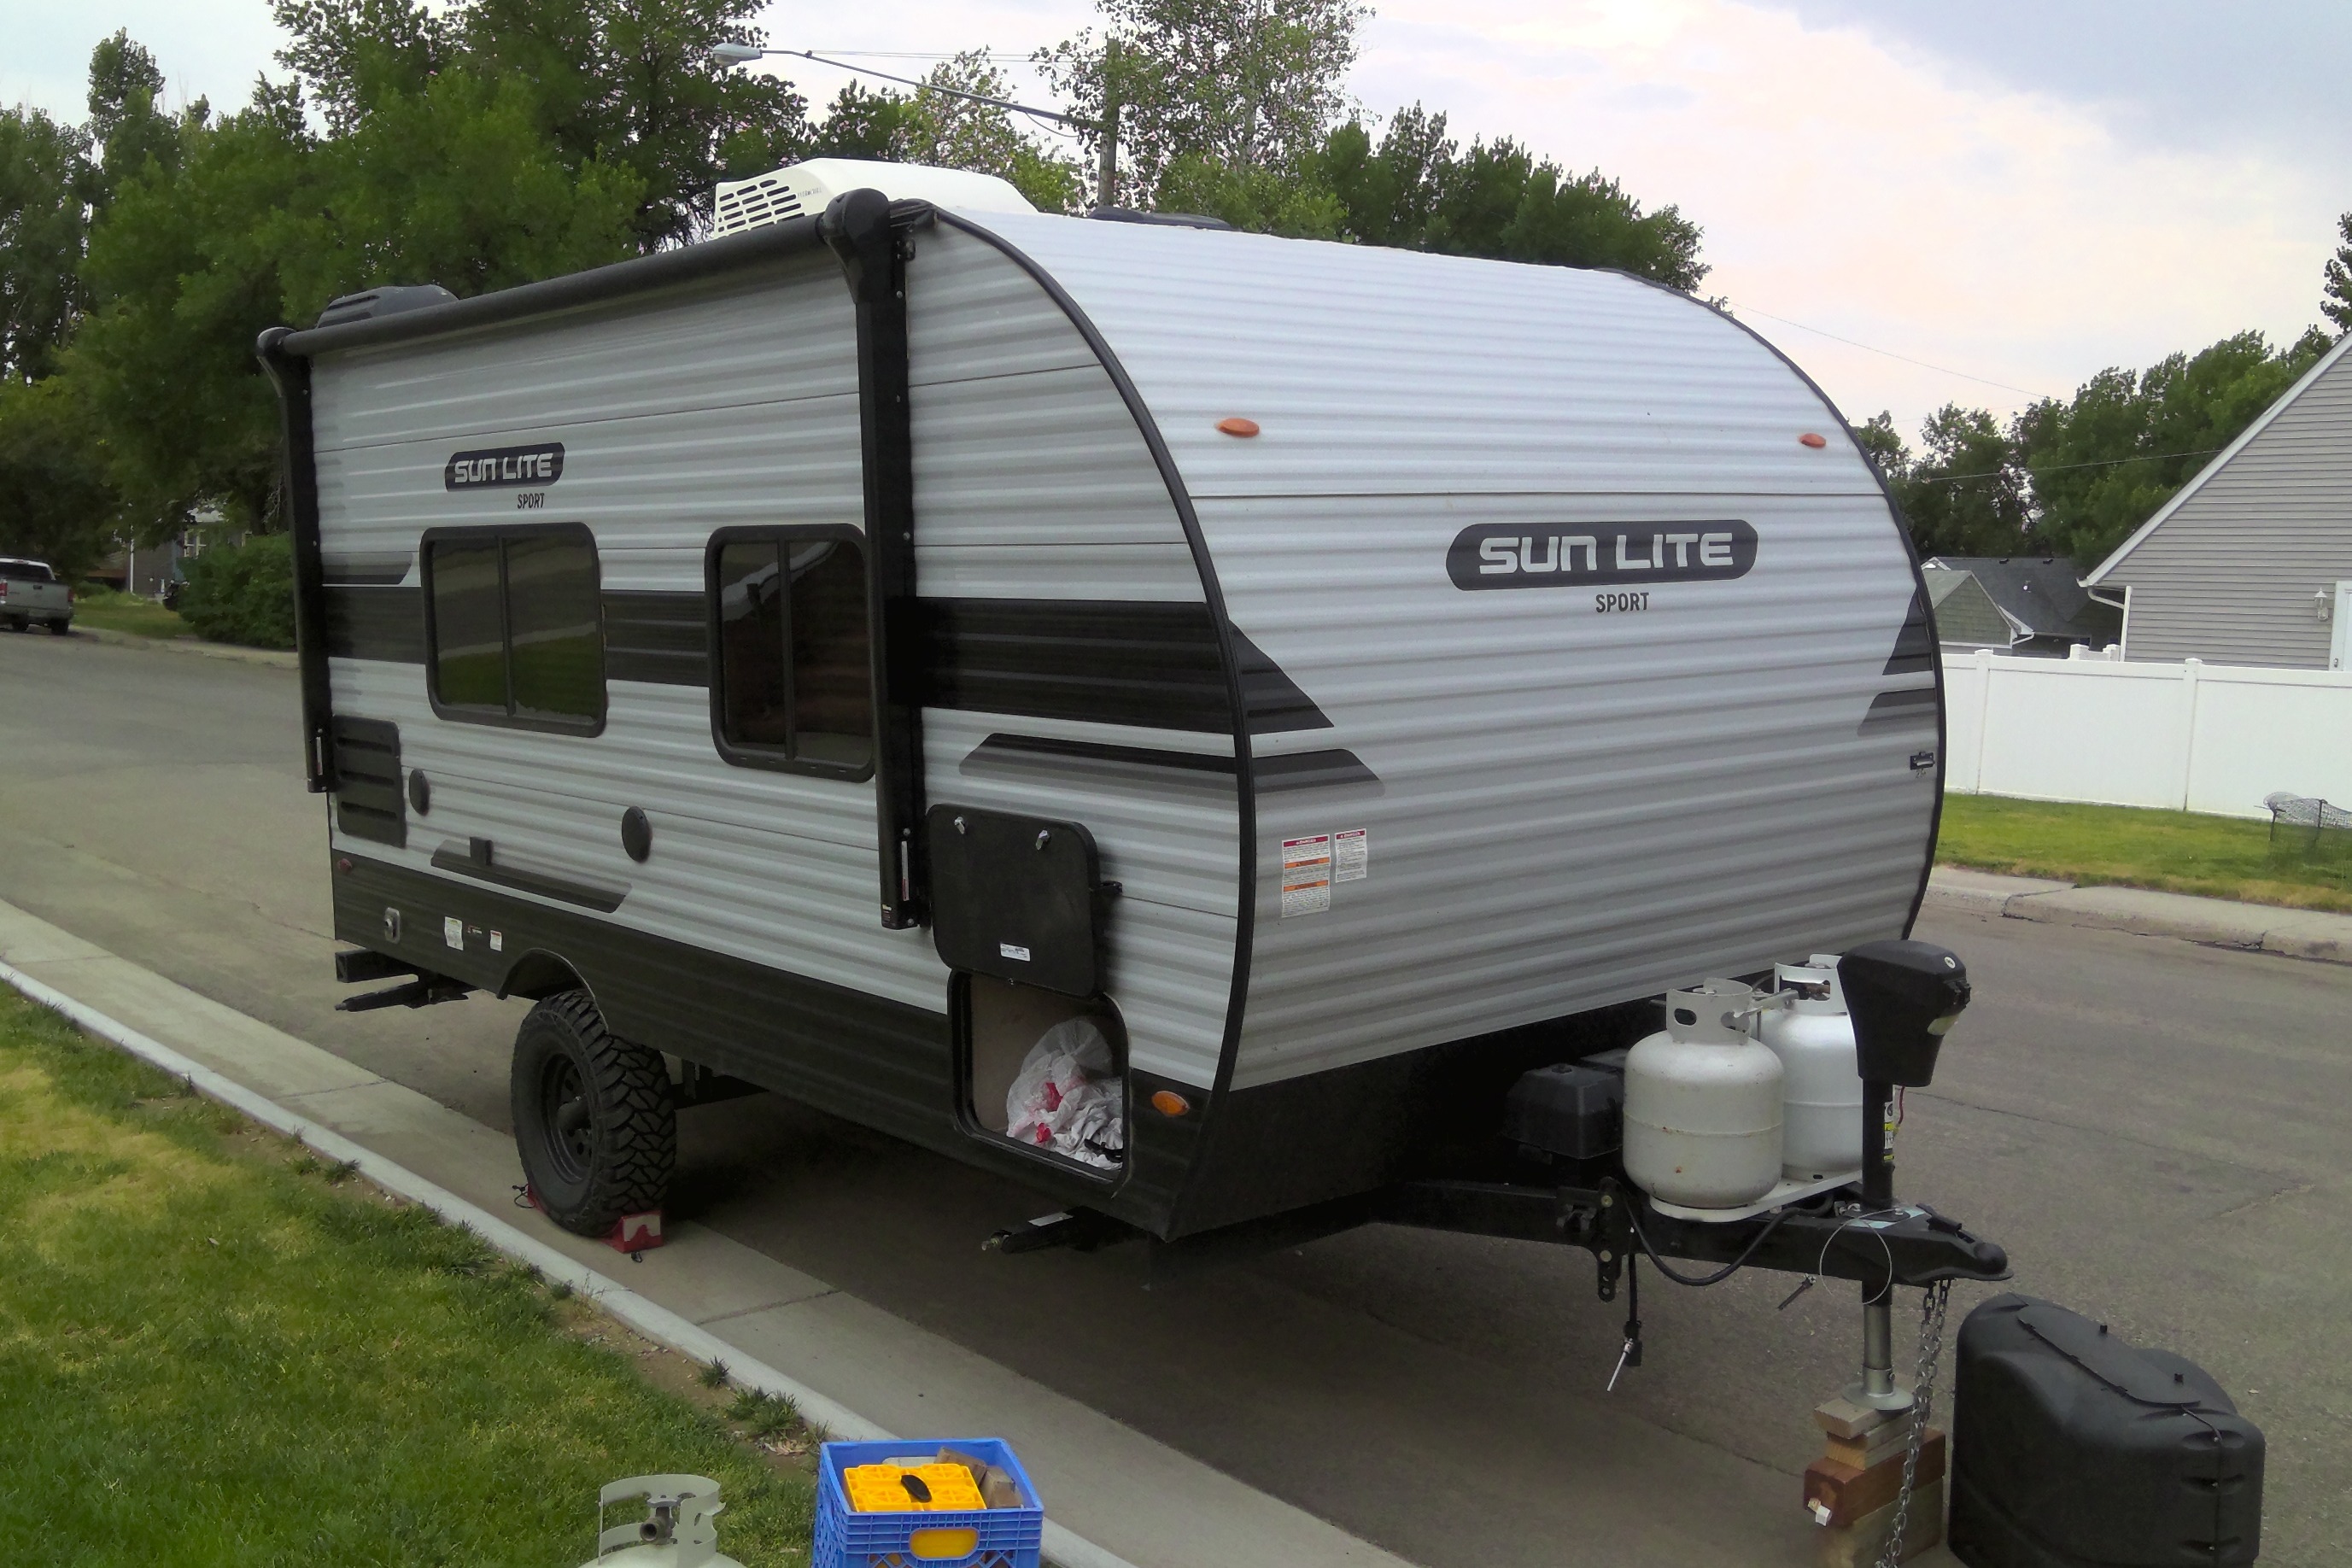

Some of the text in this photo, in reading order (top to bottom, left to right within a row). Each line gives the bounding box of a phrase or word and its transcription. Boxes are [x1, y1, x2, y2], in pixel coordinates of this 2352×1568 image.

[454, 453, 553, 483] SUN LITE
[517, 493, 545, 509] SPORT
[1479, 533, 1734, 575] SUN LITE
[1595, 592, 1649, 612] SPORT
